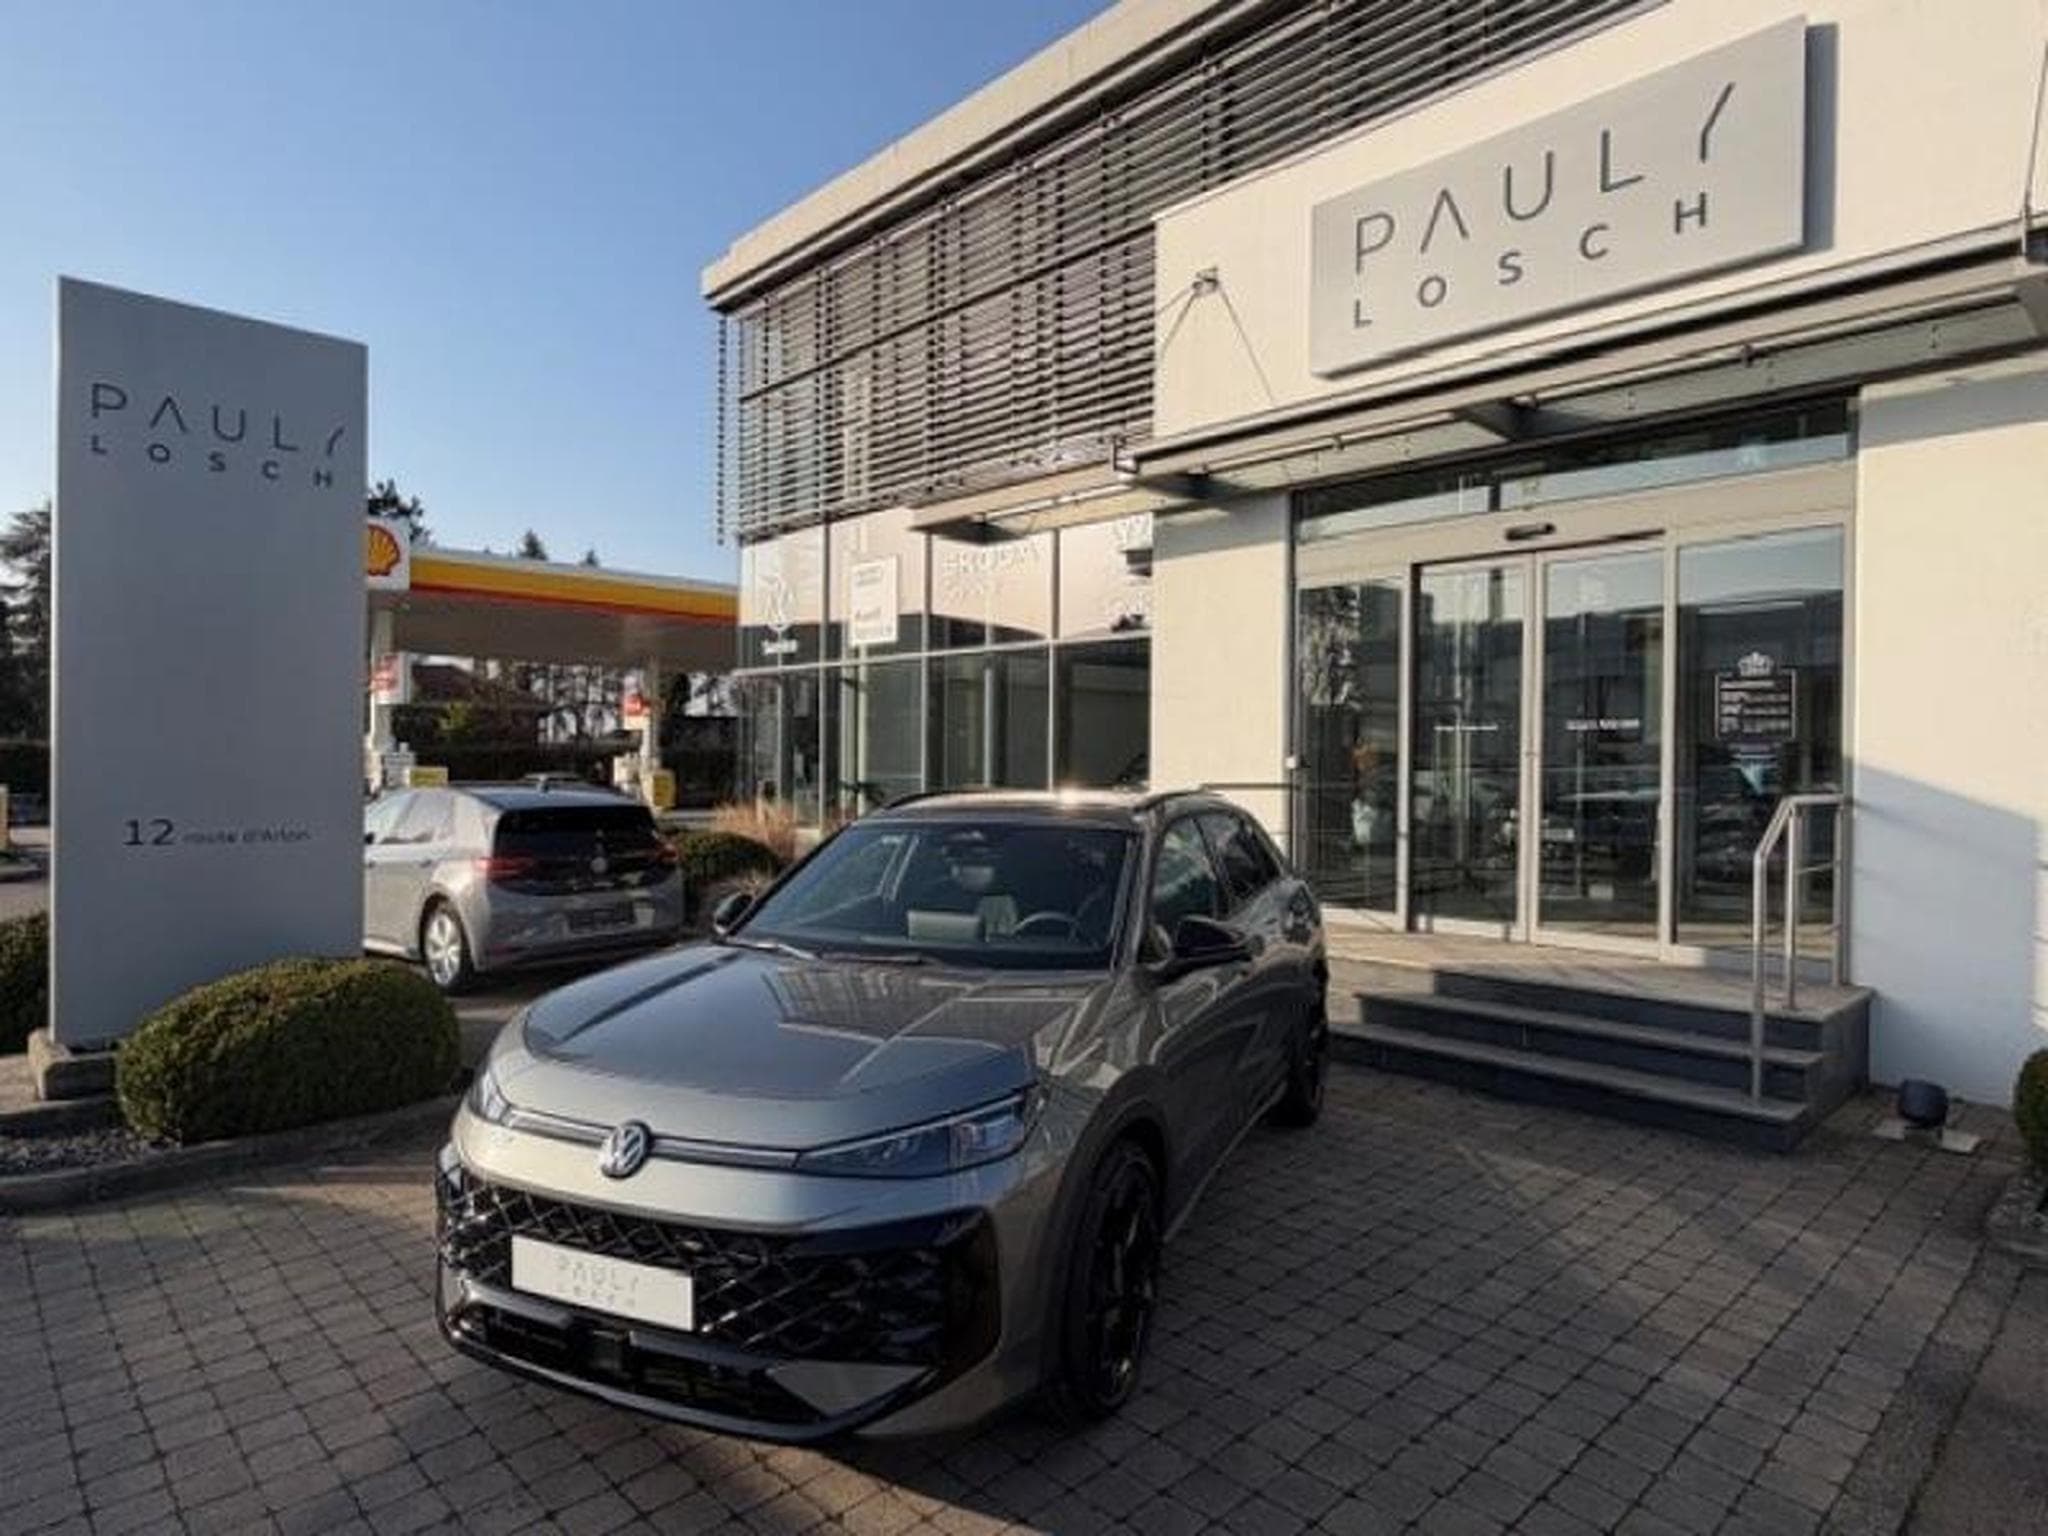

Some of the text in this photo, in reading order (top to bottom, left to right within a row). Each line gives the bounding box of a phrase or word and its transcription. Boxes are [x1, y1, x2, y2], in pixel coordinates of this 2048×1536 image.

[1356, 82, 1736, 275] PAULY
[1354, 192, 1708, 328] LOSCH
[91, 383, 345, 456] PAULY
[91, 435, 332, 487] LOSCH
[122, 818, 176, 846] 12
